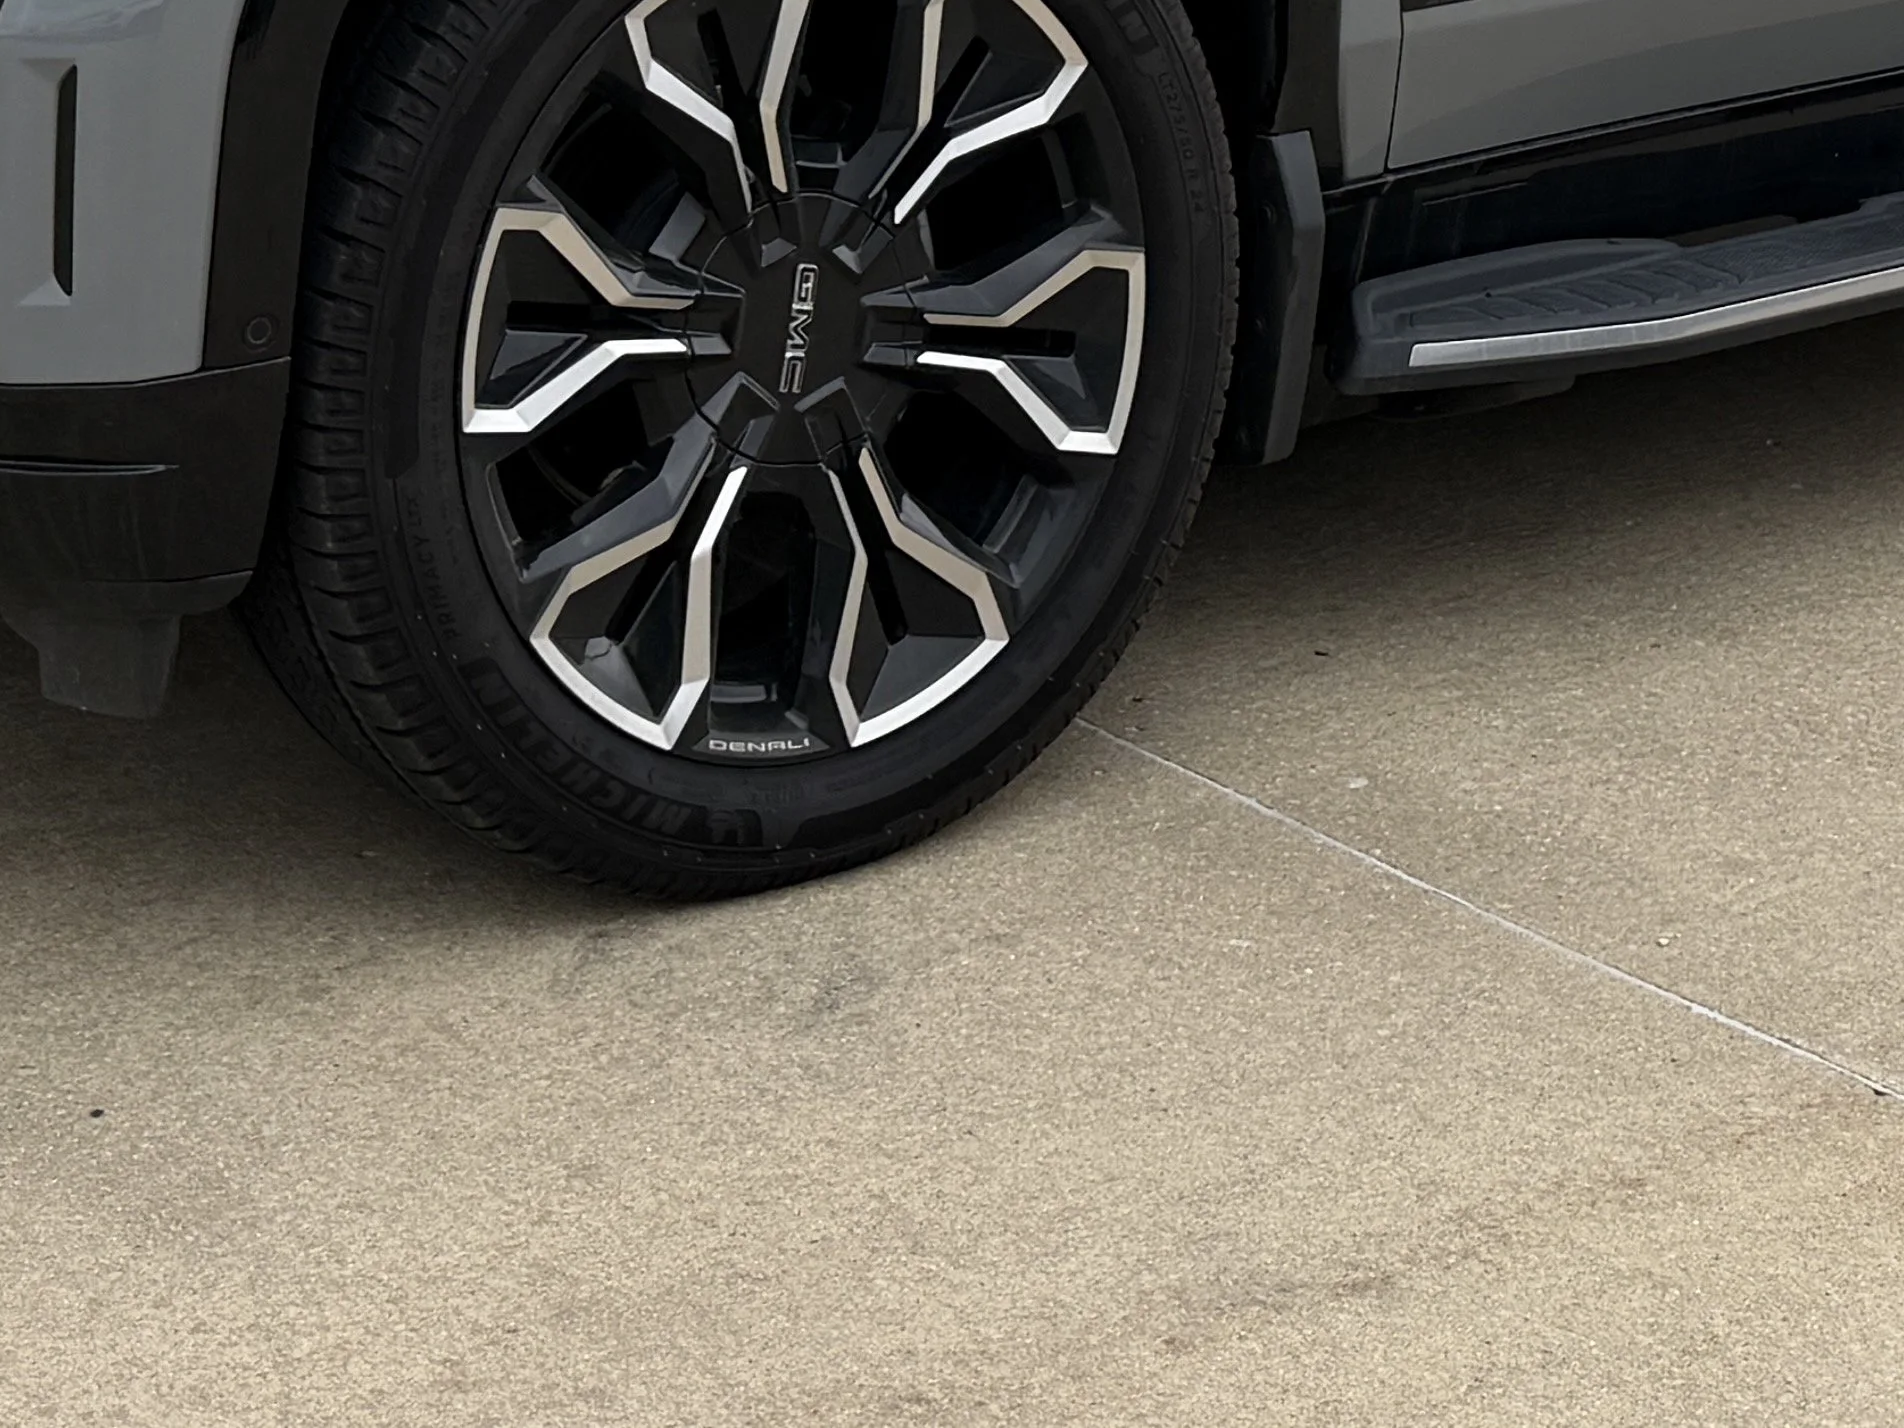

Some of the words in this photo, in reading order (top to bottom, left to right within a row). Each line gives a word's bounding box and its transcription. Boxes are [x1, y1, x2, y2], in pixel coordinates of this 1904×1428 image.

[779, 263, 819, 393] GMC
[413, 534, 462, 638] PRIMACY
[470, 665, 693, 836] MICHELIN
[709, 738, 810, 752] DENALI
